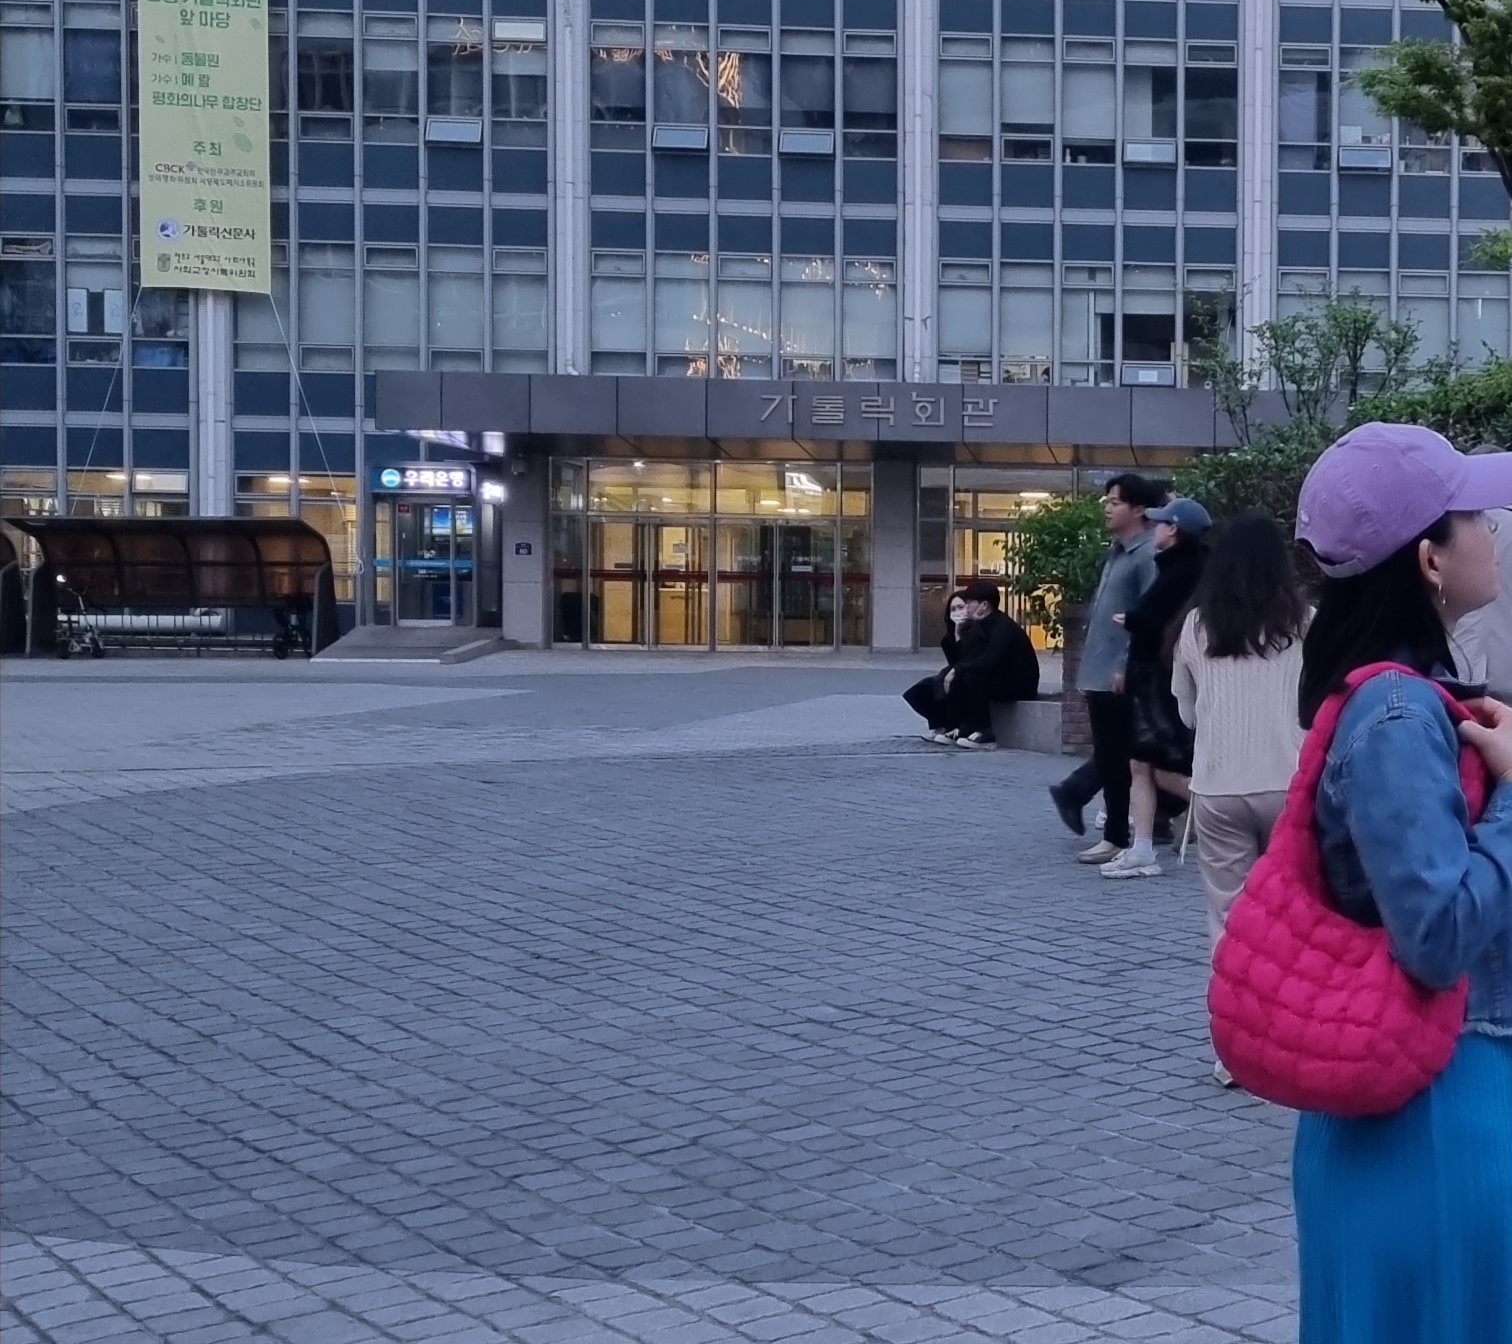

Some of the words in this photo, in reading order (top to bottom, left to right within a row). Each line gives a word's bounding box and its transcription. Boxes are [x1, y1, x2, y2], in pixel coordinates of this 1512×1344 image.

[180, 8, 195, 26] 앞
[199, 10, 231, 29] 마당
[151, 52, 172, 64] 가수
[151, 73, 172, 85] 가수
[152, 91, 219, 109] 평화의나무
[222, 95, 262, 112] 합창단
[760, 391, 998, 427] 가톨릭회관
[403, 469, 465, 488] 우리은행
